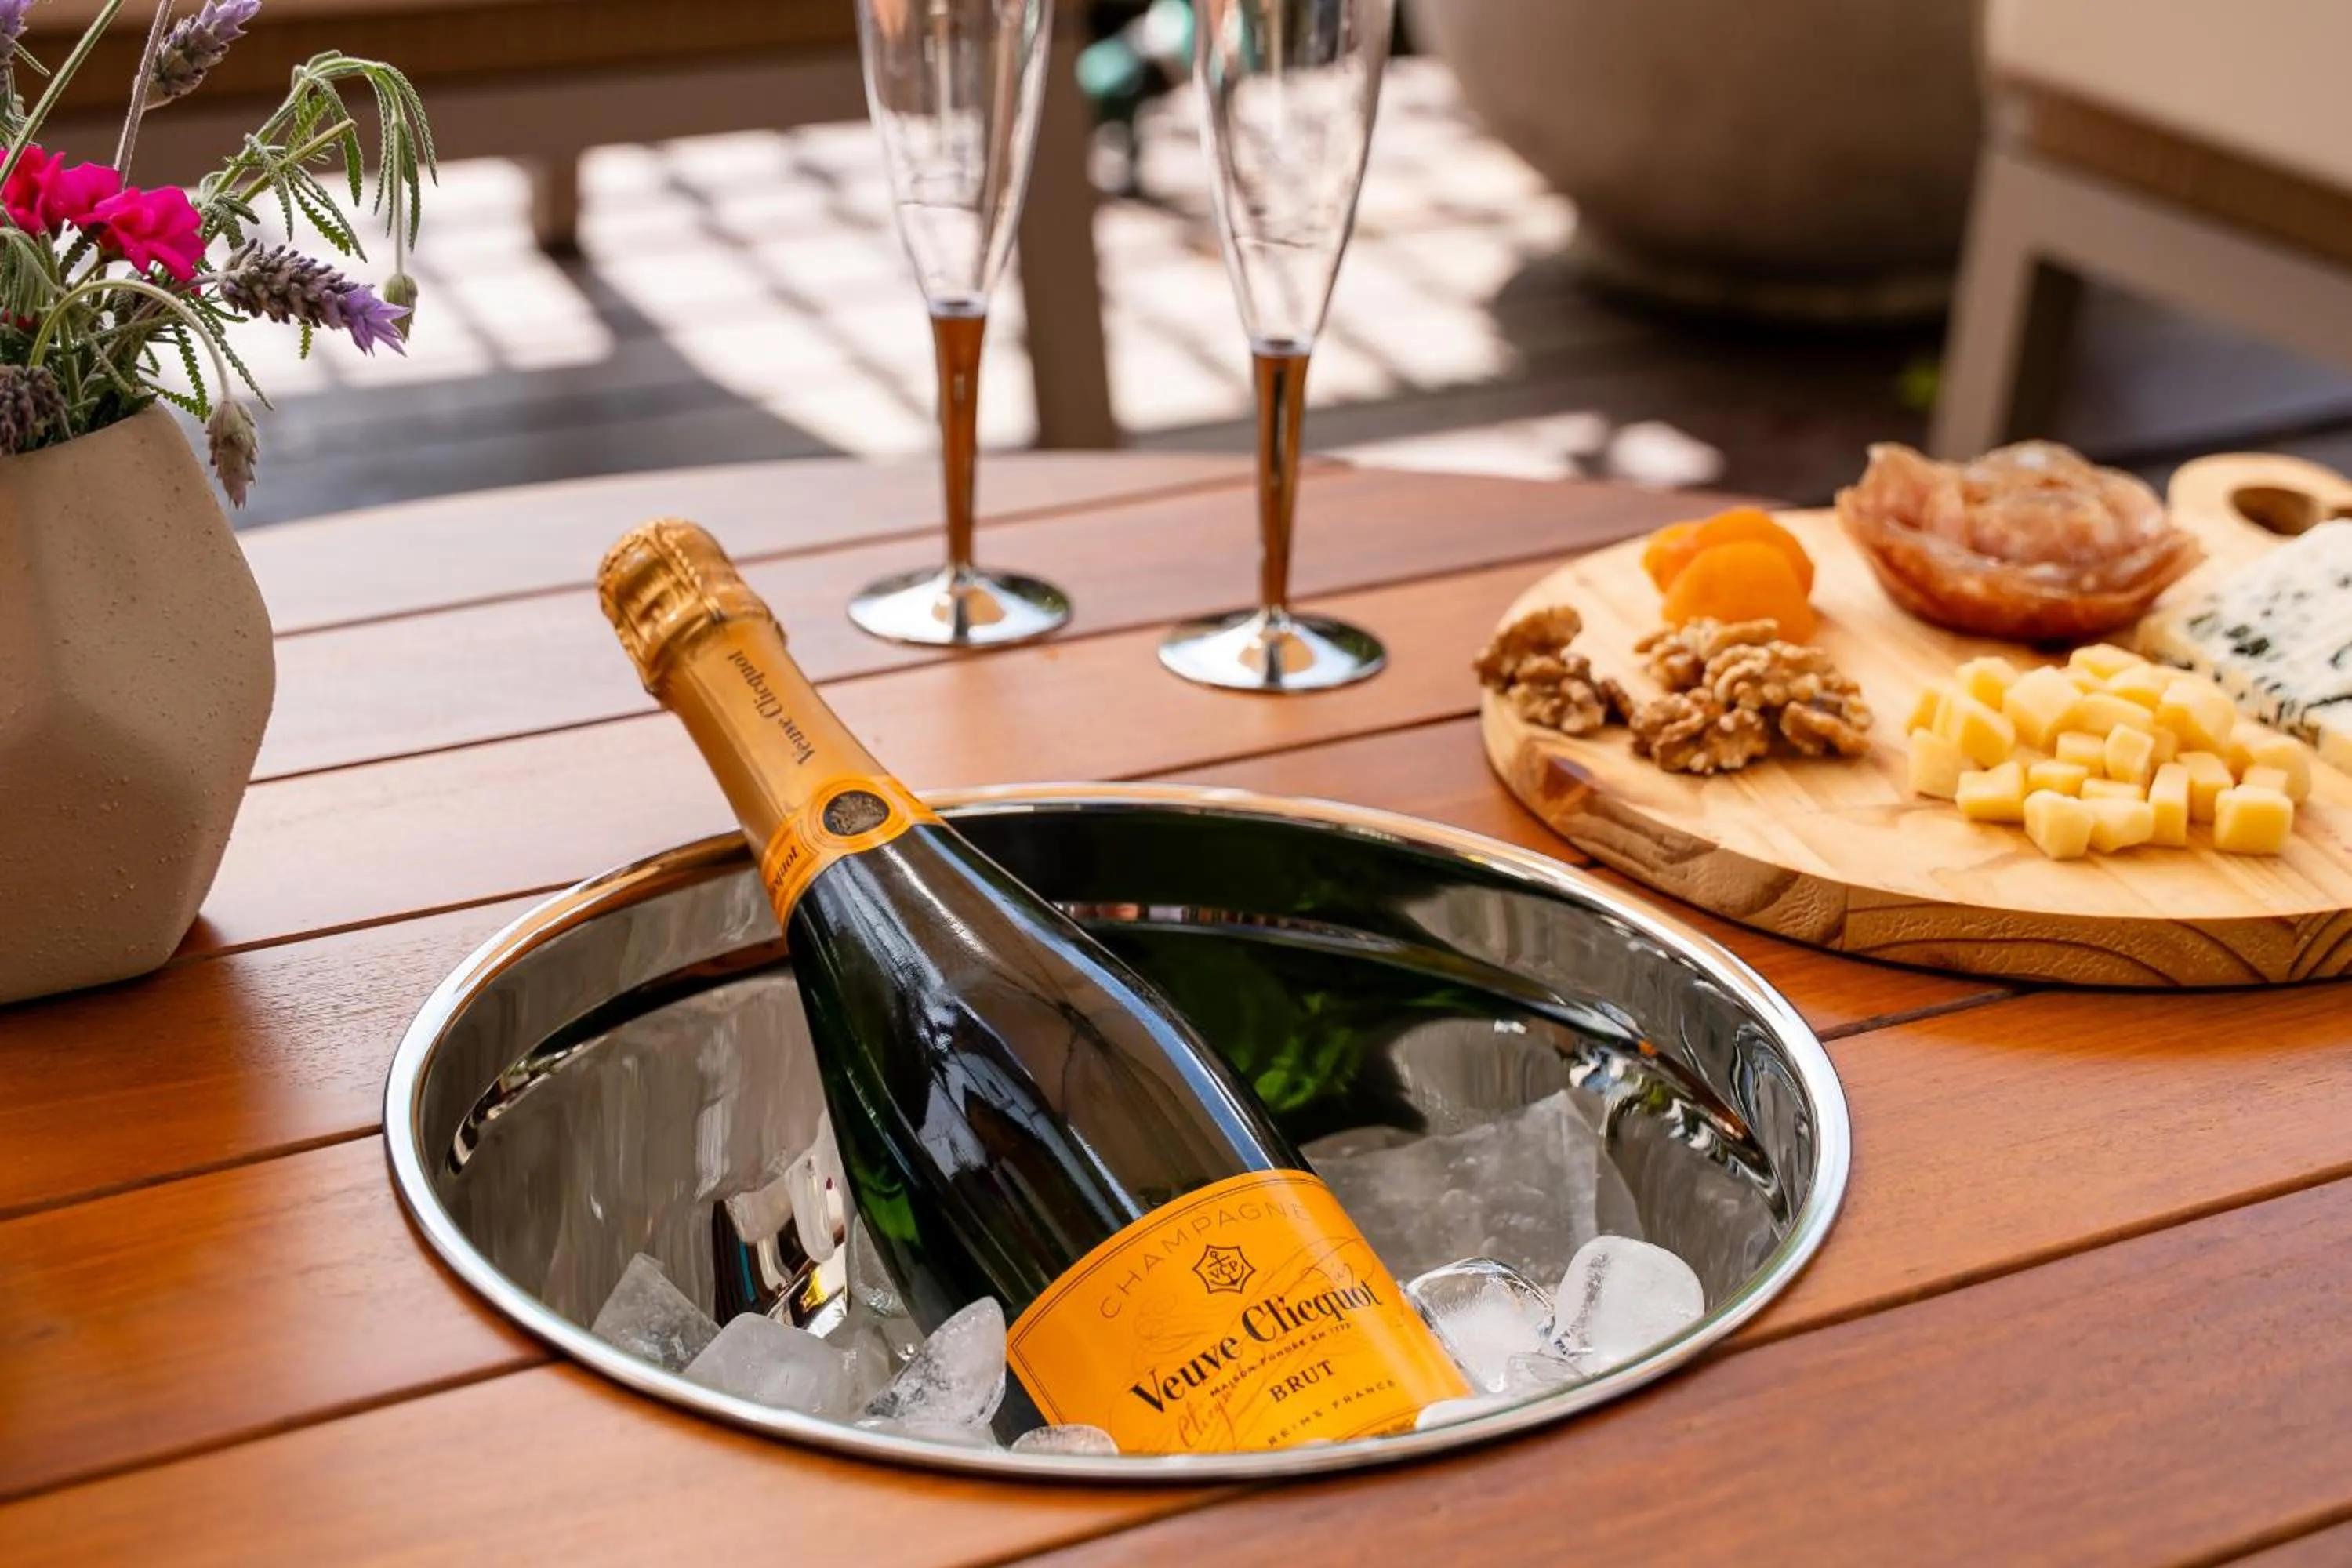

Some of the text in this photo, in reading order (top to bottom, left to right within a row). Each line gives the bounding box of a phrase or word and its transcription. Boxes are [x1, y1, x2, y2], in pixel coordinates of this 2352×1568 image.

[726, 649, 815, 766] Veuve Clicquot
[1099, 1200, 1310, 1319] CHAMPAGNE
[1128, 1279, 1382, 1413] Veuve Clicquot
[1269, 1359, 1335, 1403] BRUT
[1267, 1409, 1323, 1447] REIMS
[1331, 1378, 1396, 1410] FRANCE
